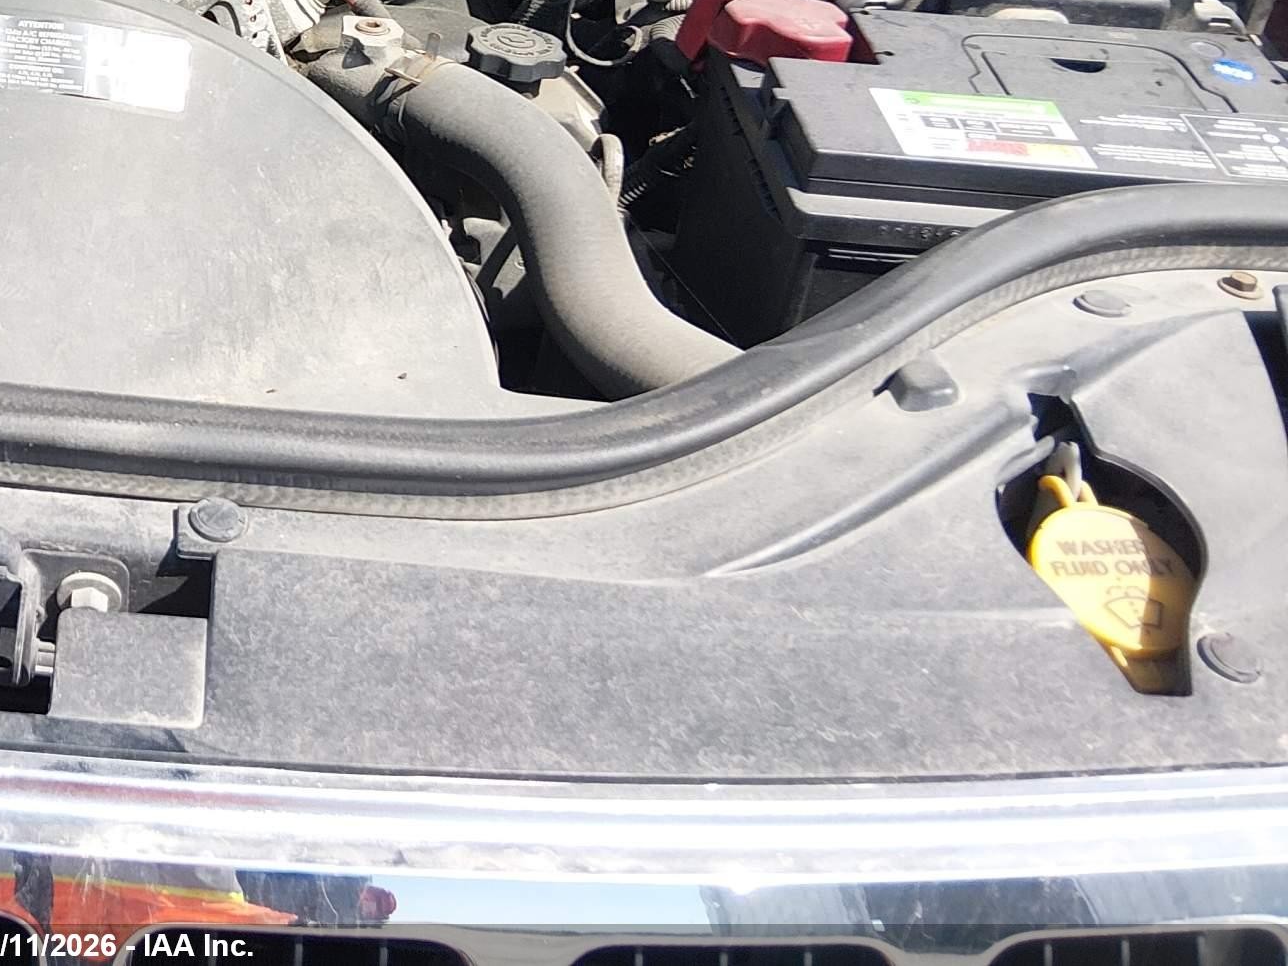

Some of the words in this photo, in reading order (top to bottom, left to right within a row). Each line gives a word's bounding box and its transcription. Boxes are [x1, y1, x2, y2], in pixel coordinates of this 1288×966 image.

[6, 35, 39, 44] FACTORY
[1056, 538, 1147, 556] WASHER
[1050, 559, 1109, 577] FLUID
[1114, 556, 1174, 577] ONLY
